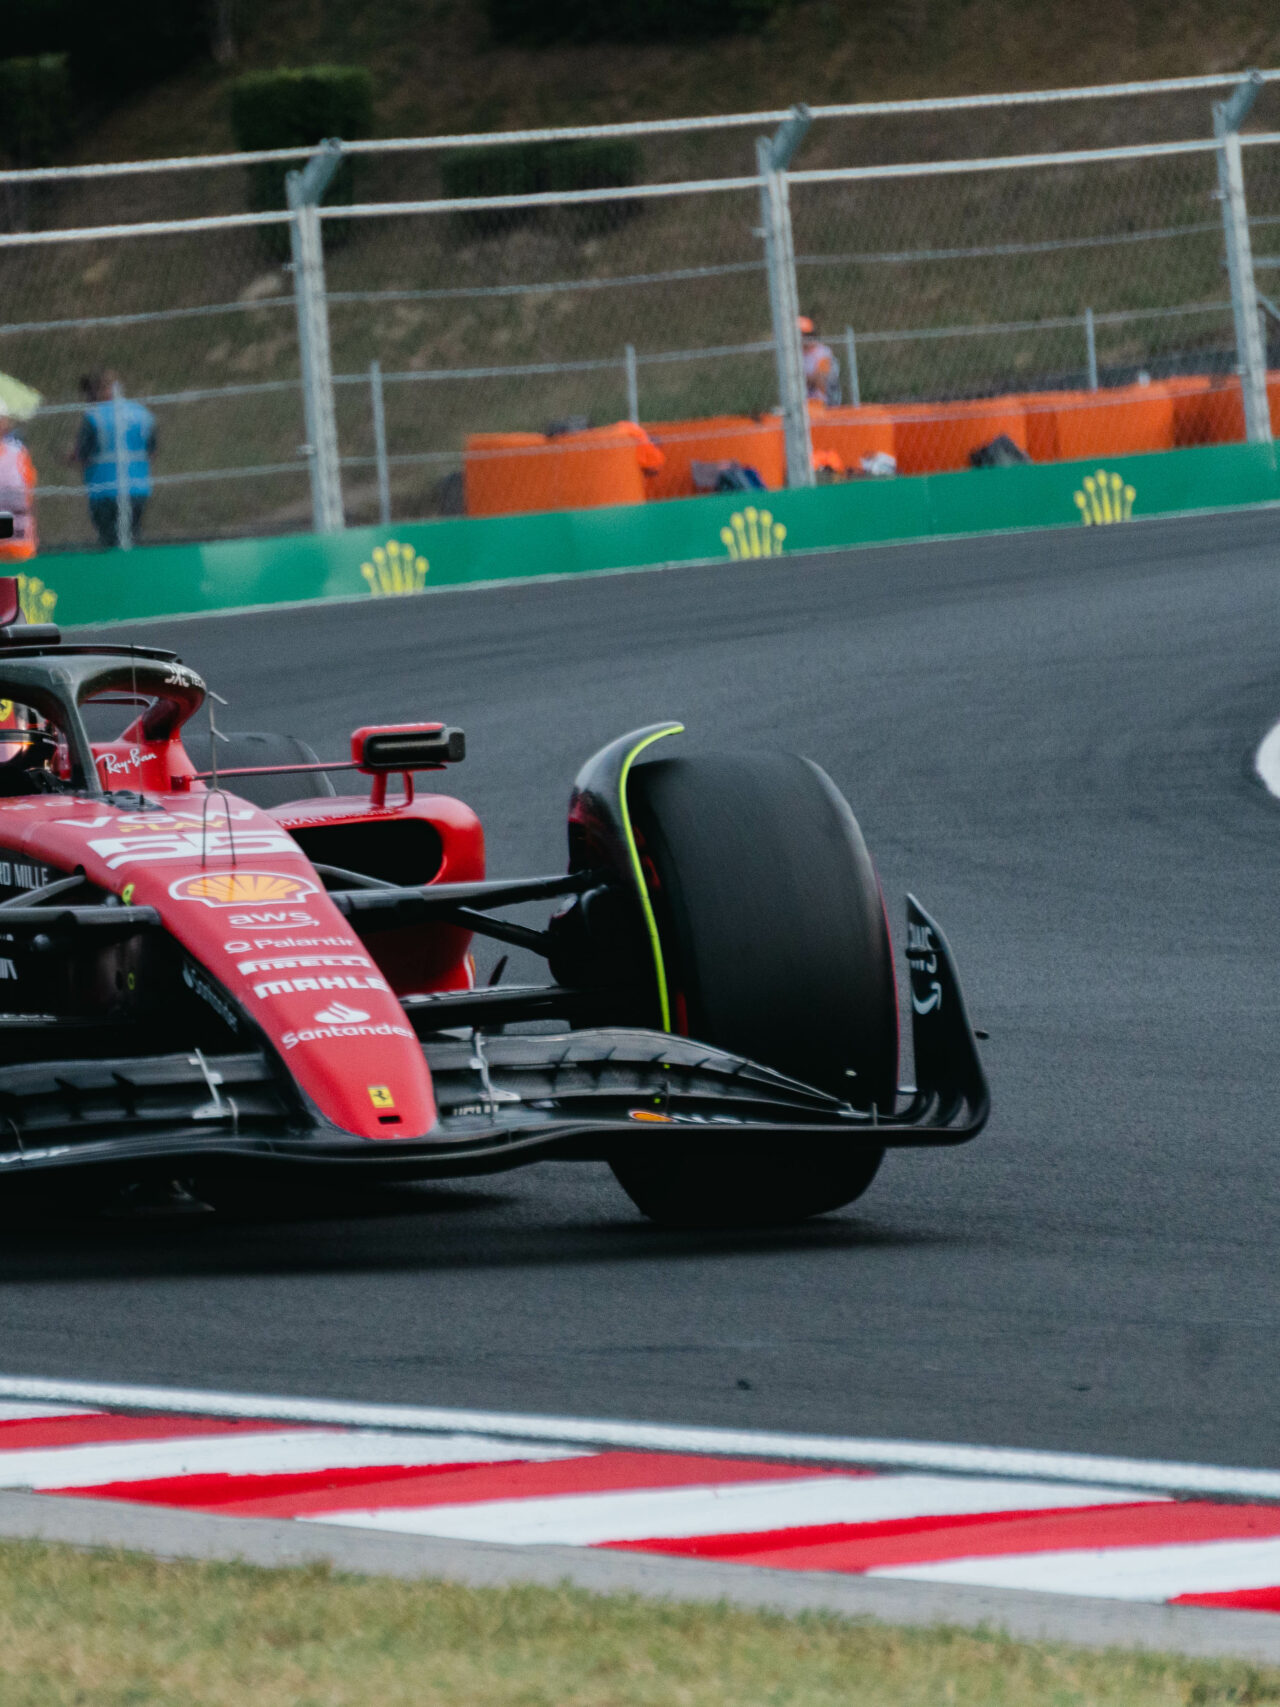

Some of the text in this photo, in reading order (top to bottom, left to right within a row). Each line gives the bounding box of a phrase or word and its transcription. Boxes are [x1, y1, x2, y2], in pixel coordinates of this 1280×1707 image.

[95, 748, 158, 774] Ray-Ban
[53, 809, 255, 828] VGW
[119, 820, 227, 833] PLAY
[274, 815, 326, 828] MAN
[87, 830, 306, 870] 55
[13, 864, 49, 889] MILLE
[228, 911, 315, 926] aws
[254, 937, 355, 949] Palantir
[237, 956, 372, 975] PIRELLI
[253, 977, 390, 999] MAHLE
[281, 1024, 415, 1049] Santander
